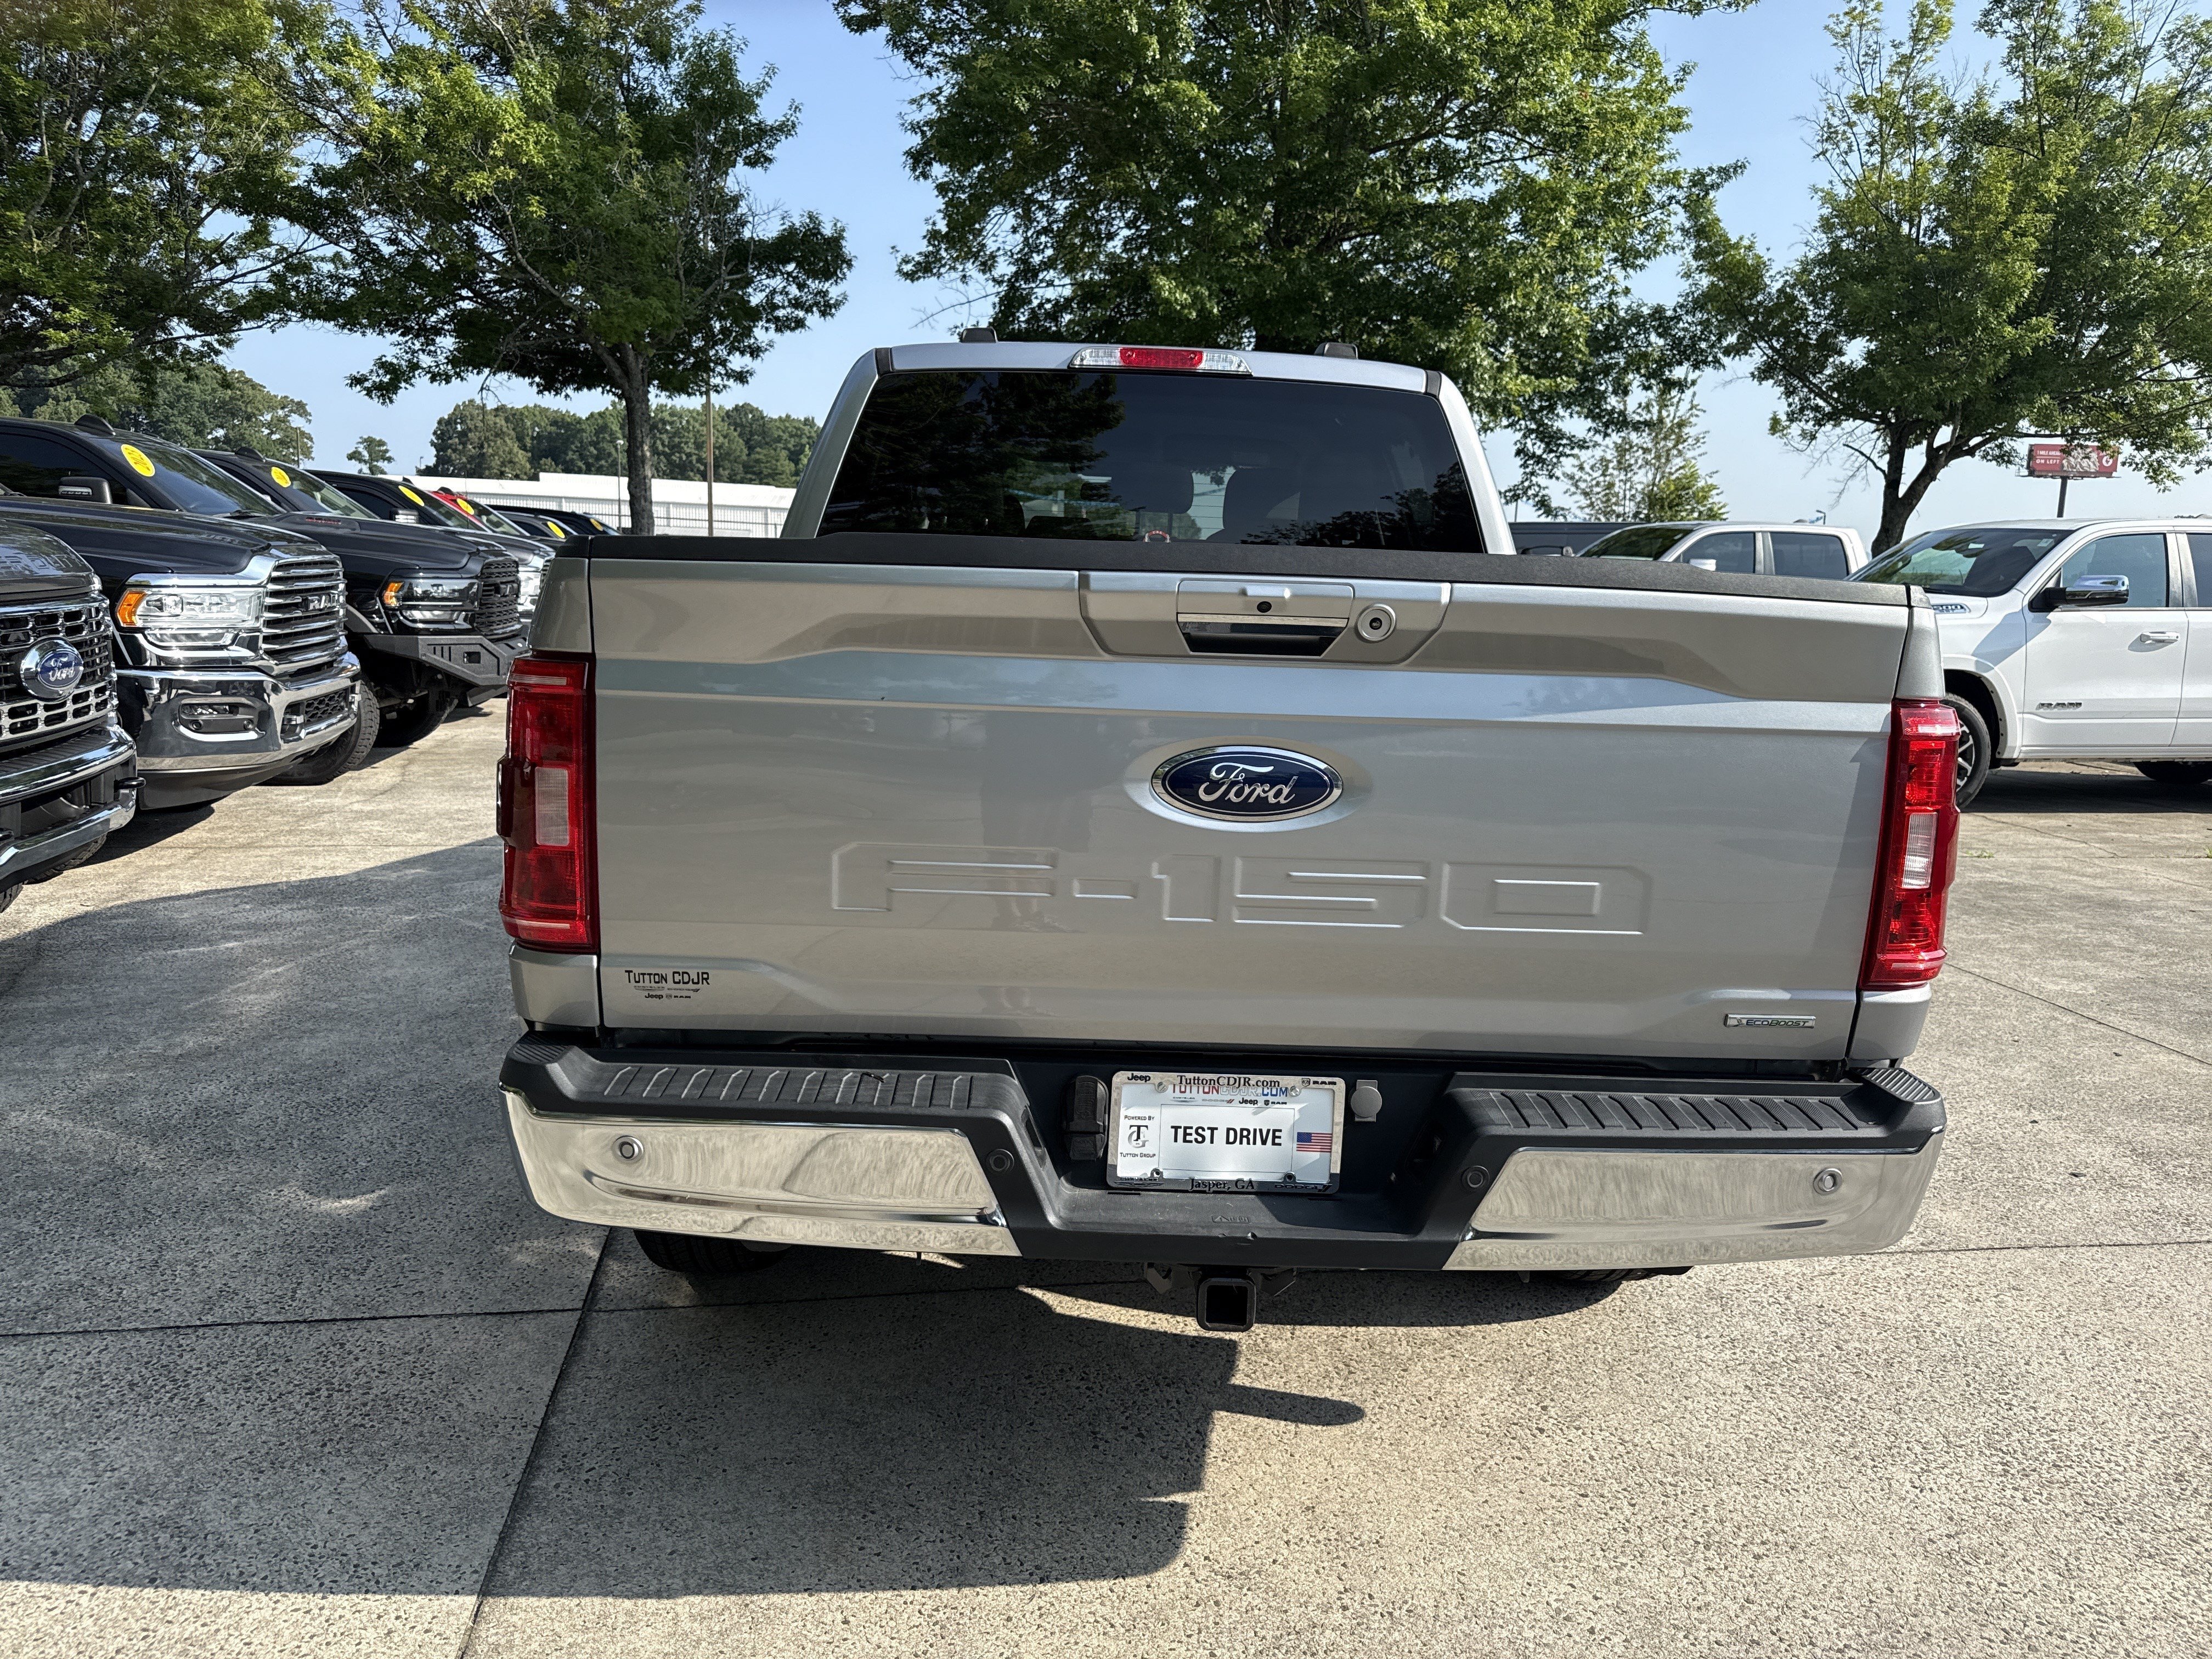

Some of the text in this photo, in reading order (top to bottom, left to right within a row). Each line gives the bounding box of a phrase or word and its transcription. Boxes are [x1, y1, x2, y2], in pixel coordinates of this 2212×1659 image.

[48, 656, 76, 682] Ford
[2035, 702, 2083, 710] RAM
[1198, 761, 1300, 805] Ford
[831, 842, 1652, 936] F-150
[672, 971, 710, 985] CDJR
[1127, 1073, 1151, 1083] Jeep
[1177, 1075, 1280, 1088] TuttonCDJR.com
[1238, 1097, 1259, 1105] Jeep
[1170, 1125, 1283, 1146] TEST DRIVE
[1189, 1177, 1255, 1192] Jasper, GA
